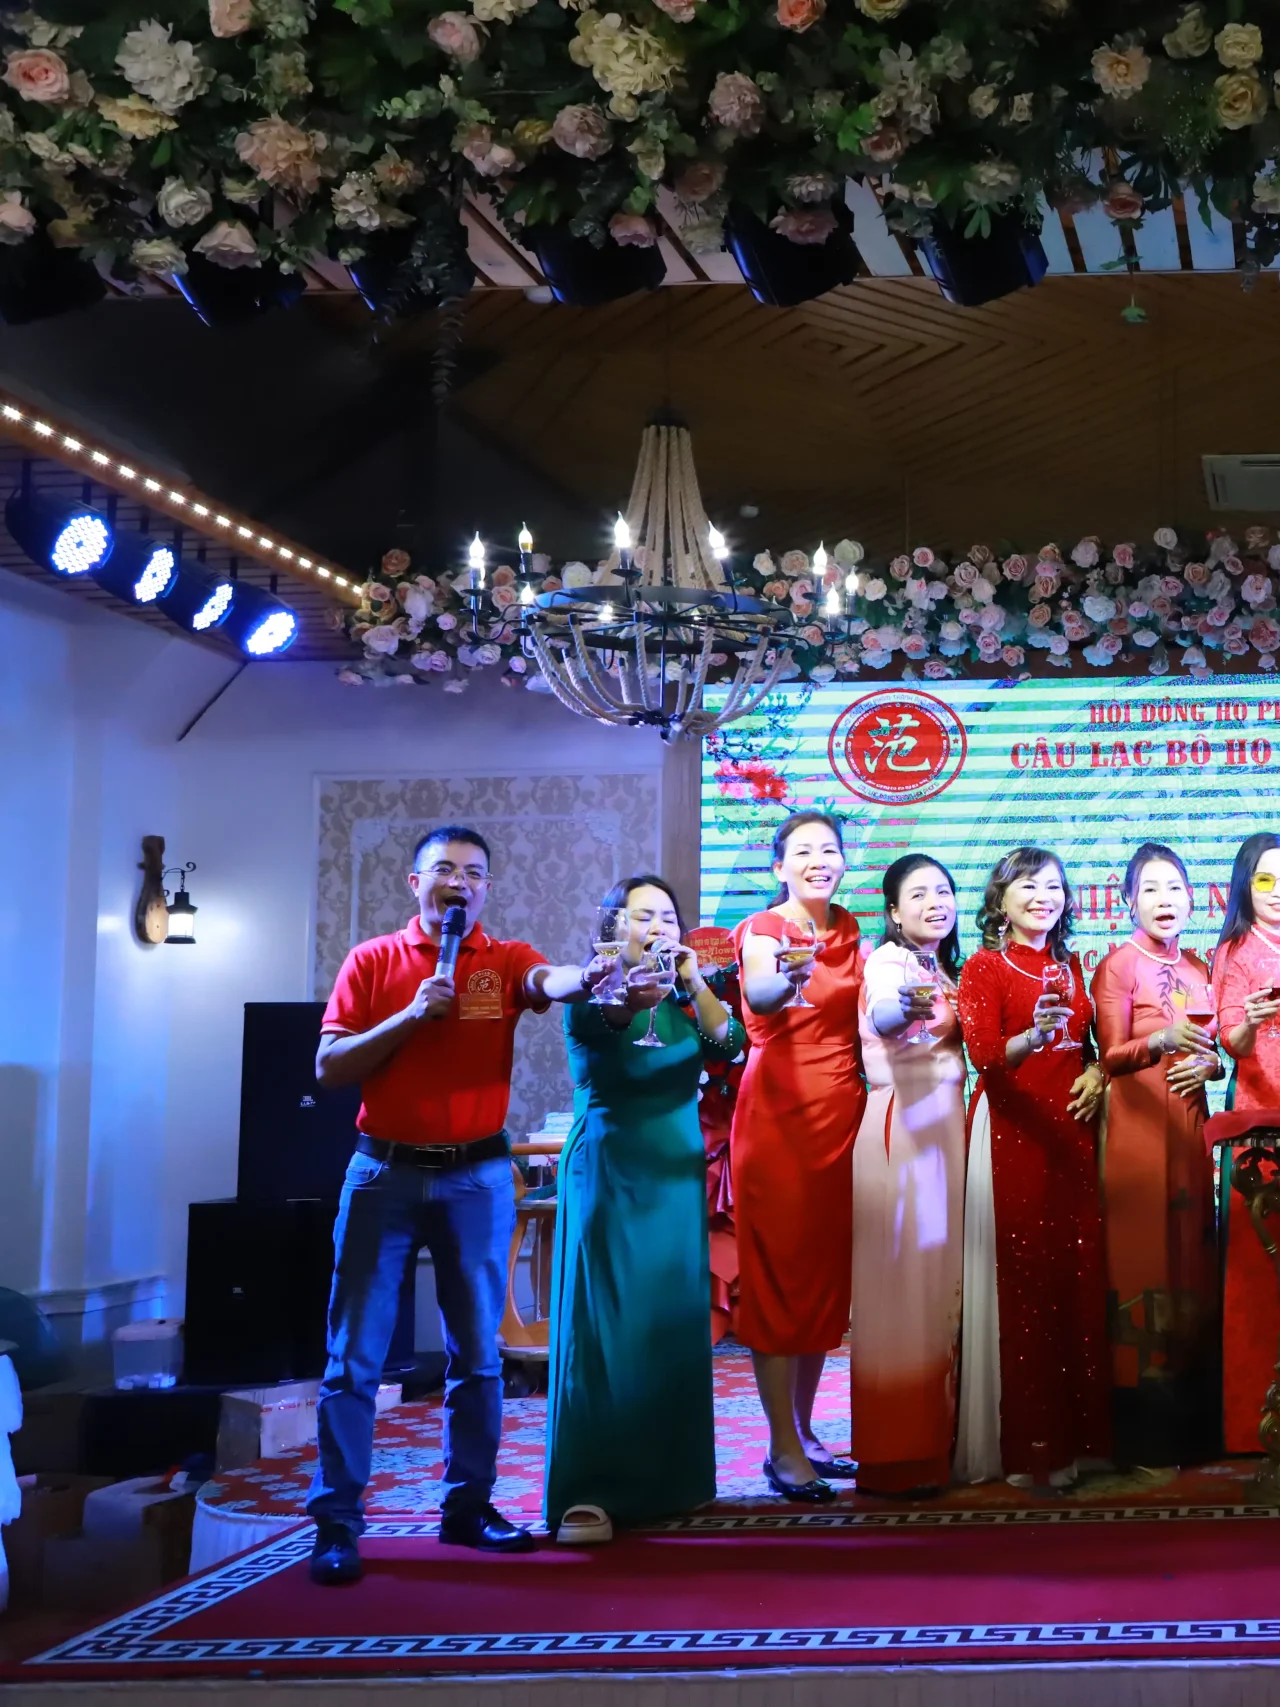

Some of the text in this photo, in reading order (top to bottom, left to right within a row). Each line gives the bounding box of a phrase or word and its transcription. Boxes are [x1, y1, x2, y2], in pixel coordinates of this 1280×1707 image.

[1009, 736, 1077, 770] CÂU
[1089, 739, 1153, 771] LẠC
[1165, 732, 1213, 770] BỘ
